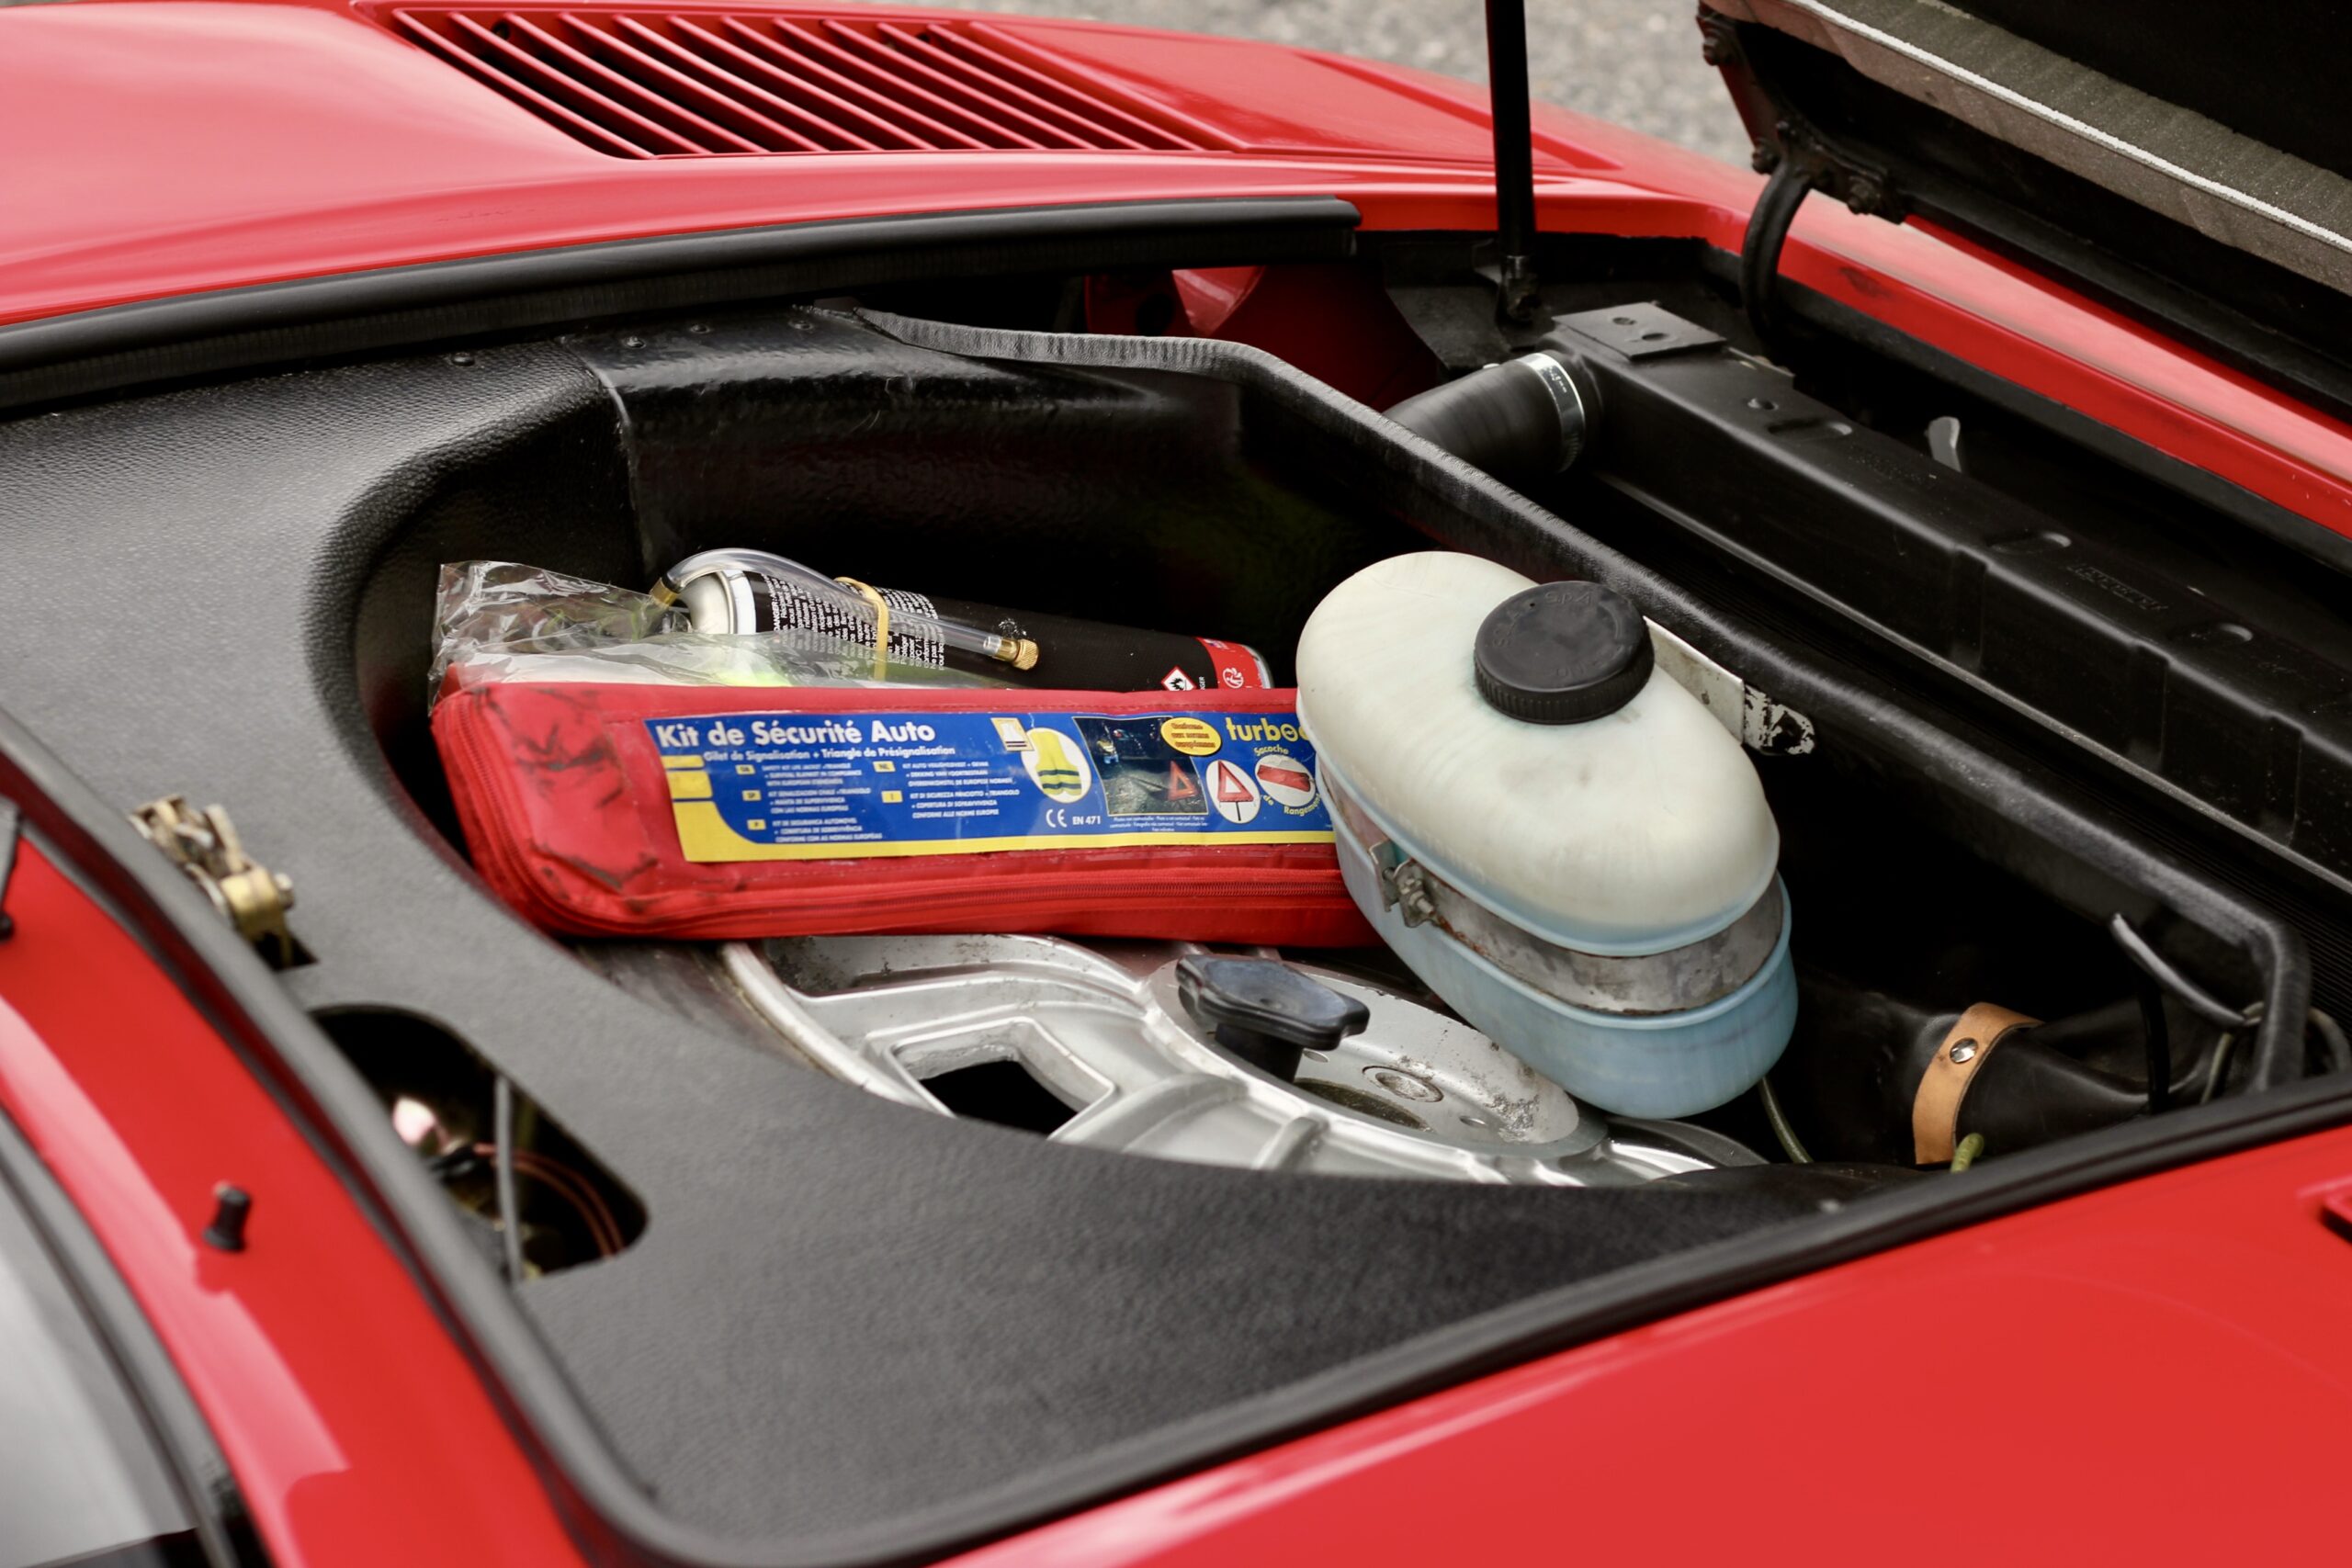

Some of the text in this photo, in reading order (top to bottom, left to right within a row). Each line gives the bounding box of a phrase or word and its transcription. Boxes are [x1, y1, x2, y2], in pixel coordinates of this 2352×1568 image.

[777, 592, 787, 618] Récipient
[802, 603, 810, 627] néfastes
[817, 604, 826, 630] récipient
[656, 719, 936, 748] Kit de Sécurité Auto
[704, 751, 726, 761] Gilet
[728, 751, 743, 761] de
[746, 750, 810, 762] Signalisation
[822, 748, 862, 760] Triangle
[864, 748, 876, 757] de
[878, 745, 956, 758] Présignalisation
[1253, 744, 1289, 756] Sacoche
[1263, 795, 1274, 806] de
[1072, 815, 1101, 826] EN 471
